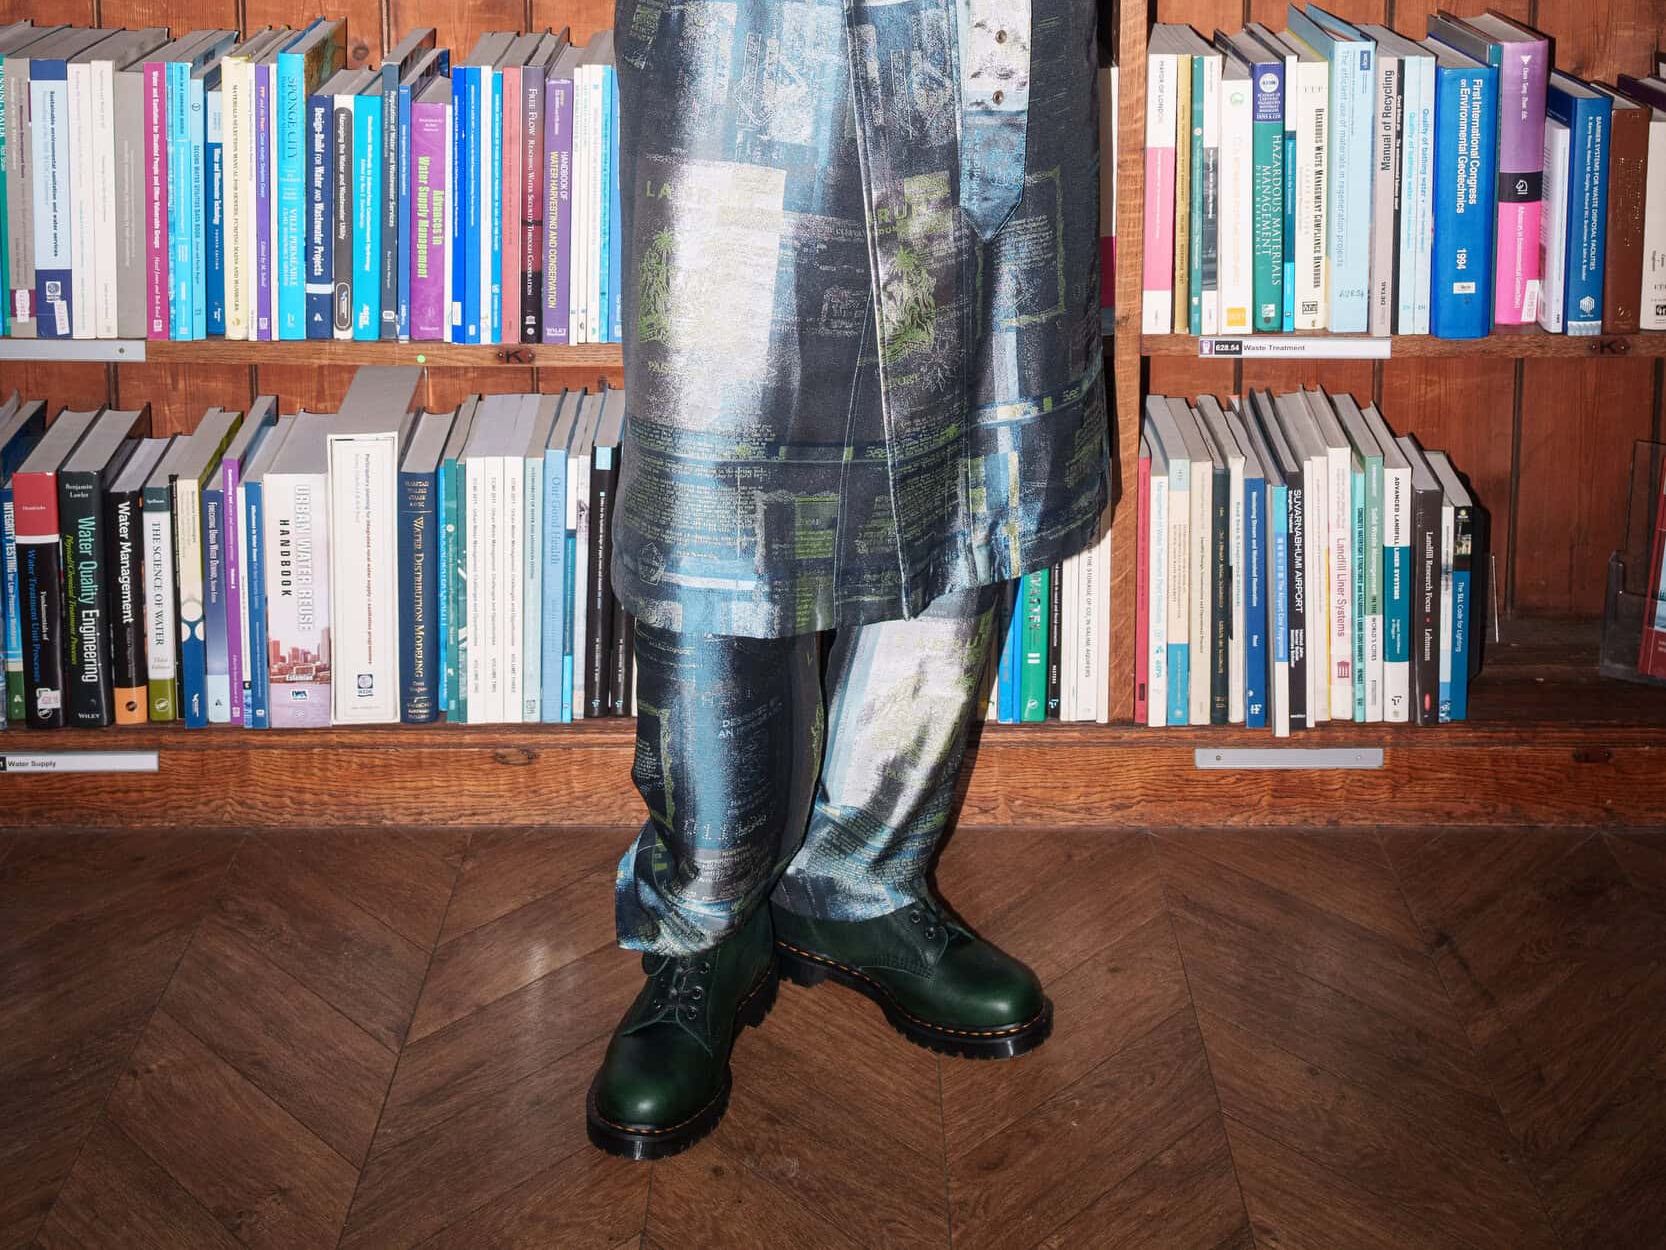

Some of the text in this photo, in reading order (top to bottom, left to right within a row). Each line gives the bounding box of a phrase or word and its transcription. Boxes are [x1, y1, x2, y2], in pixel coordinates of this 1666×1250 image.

[549, 152, 557, 178] WATER
[560, 152, 568, 200] HANDBOOK OF
[1457, 79, 1469, 213] on Environmental Geotechnics
[1467, 79, 1482, 204] First International Congress
[549, 180, 557, 228] HARVESTING
[549, 231, 557, 247] AND
[1262, 166, 1271, 255] MANAGEMENT
[1272, 135, 1281, 285] HAZARDOUS MATERIALS
[1457, 249, 1465, 269] 1994
[1215, 343, 1240, 352] 628.54
[118, 501, 134, 623] Water Management
[153, 522, 163, 645] THE SCIENCE OF WATER
[280, 520, 291, 596] HANDBOOK
[414, 517, 424, 677] WATER DISTRIBUTION MODELING
[1294, 490, 1302, 613] SUVARNABHUMI AIRPORT
[1334, 538, 1346, 636] Landfill Liner Systems
[76, 517, 100, 681] Water Quality Engineering
[8, 760, 56, 769] Water Supply
